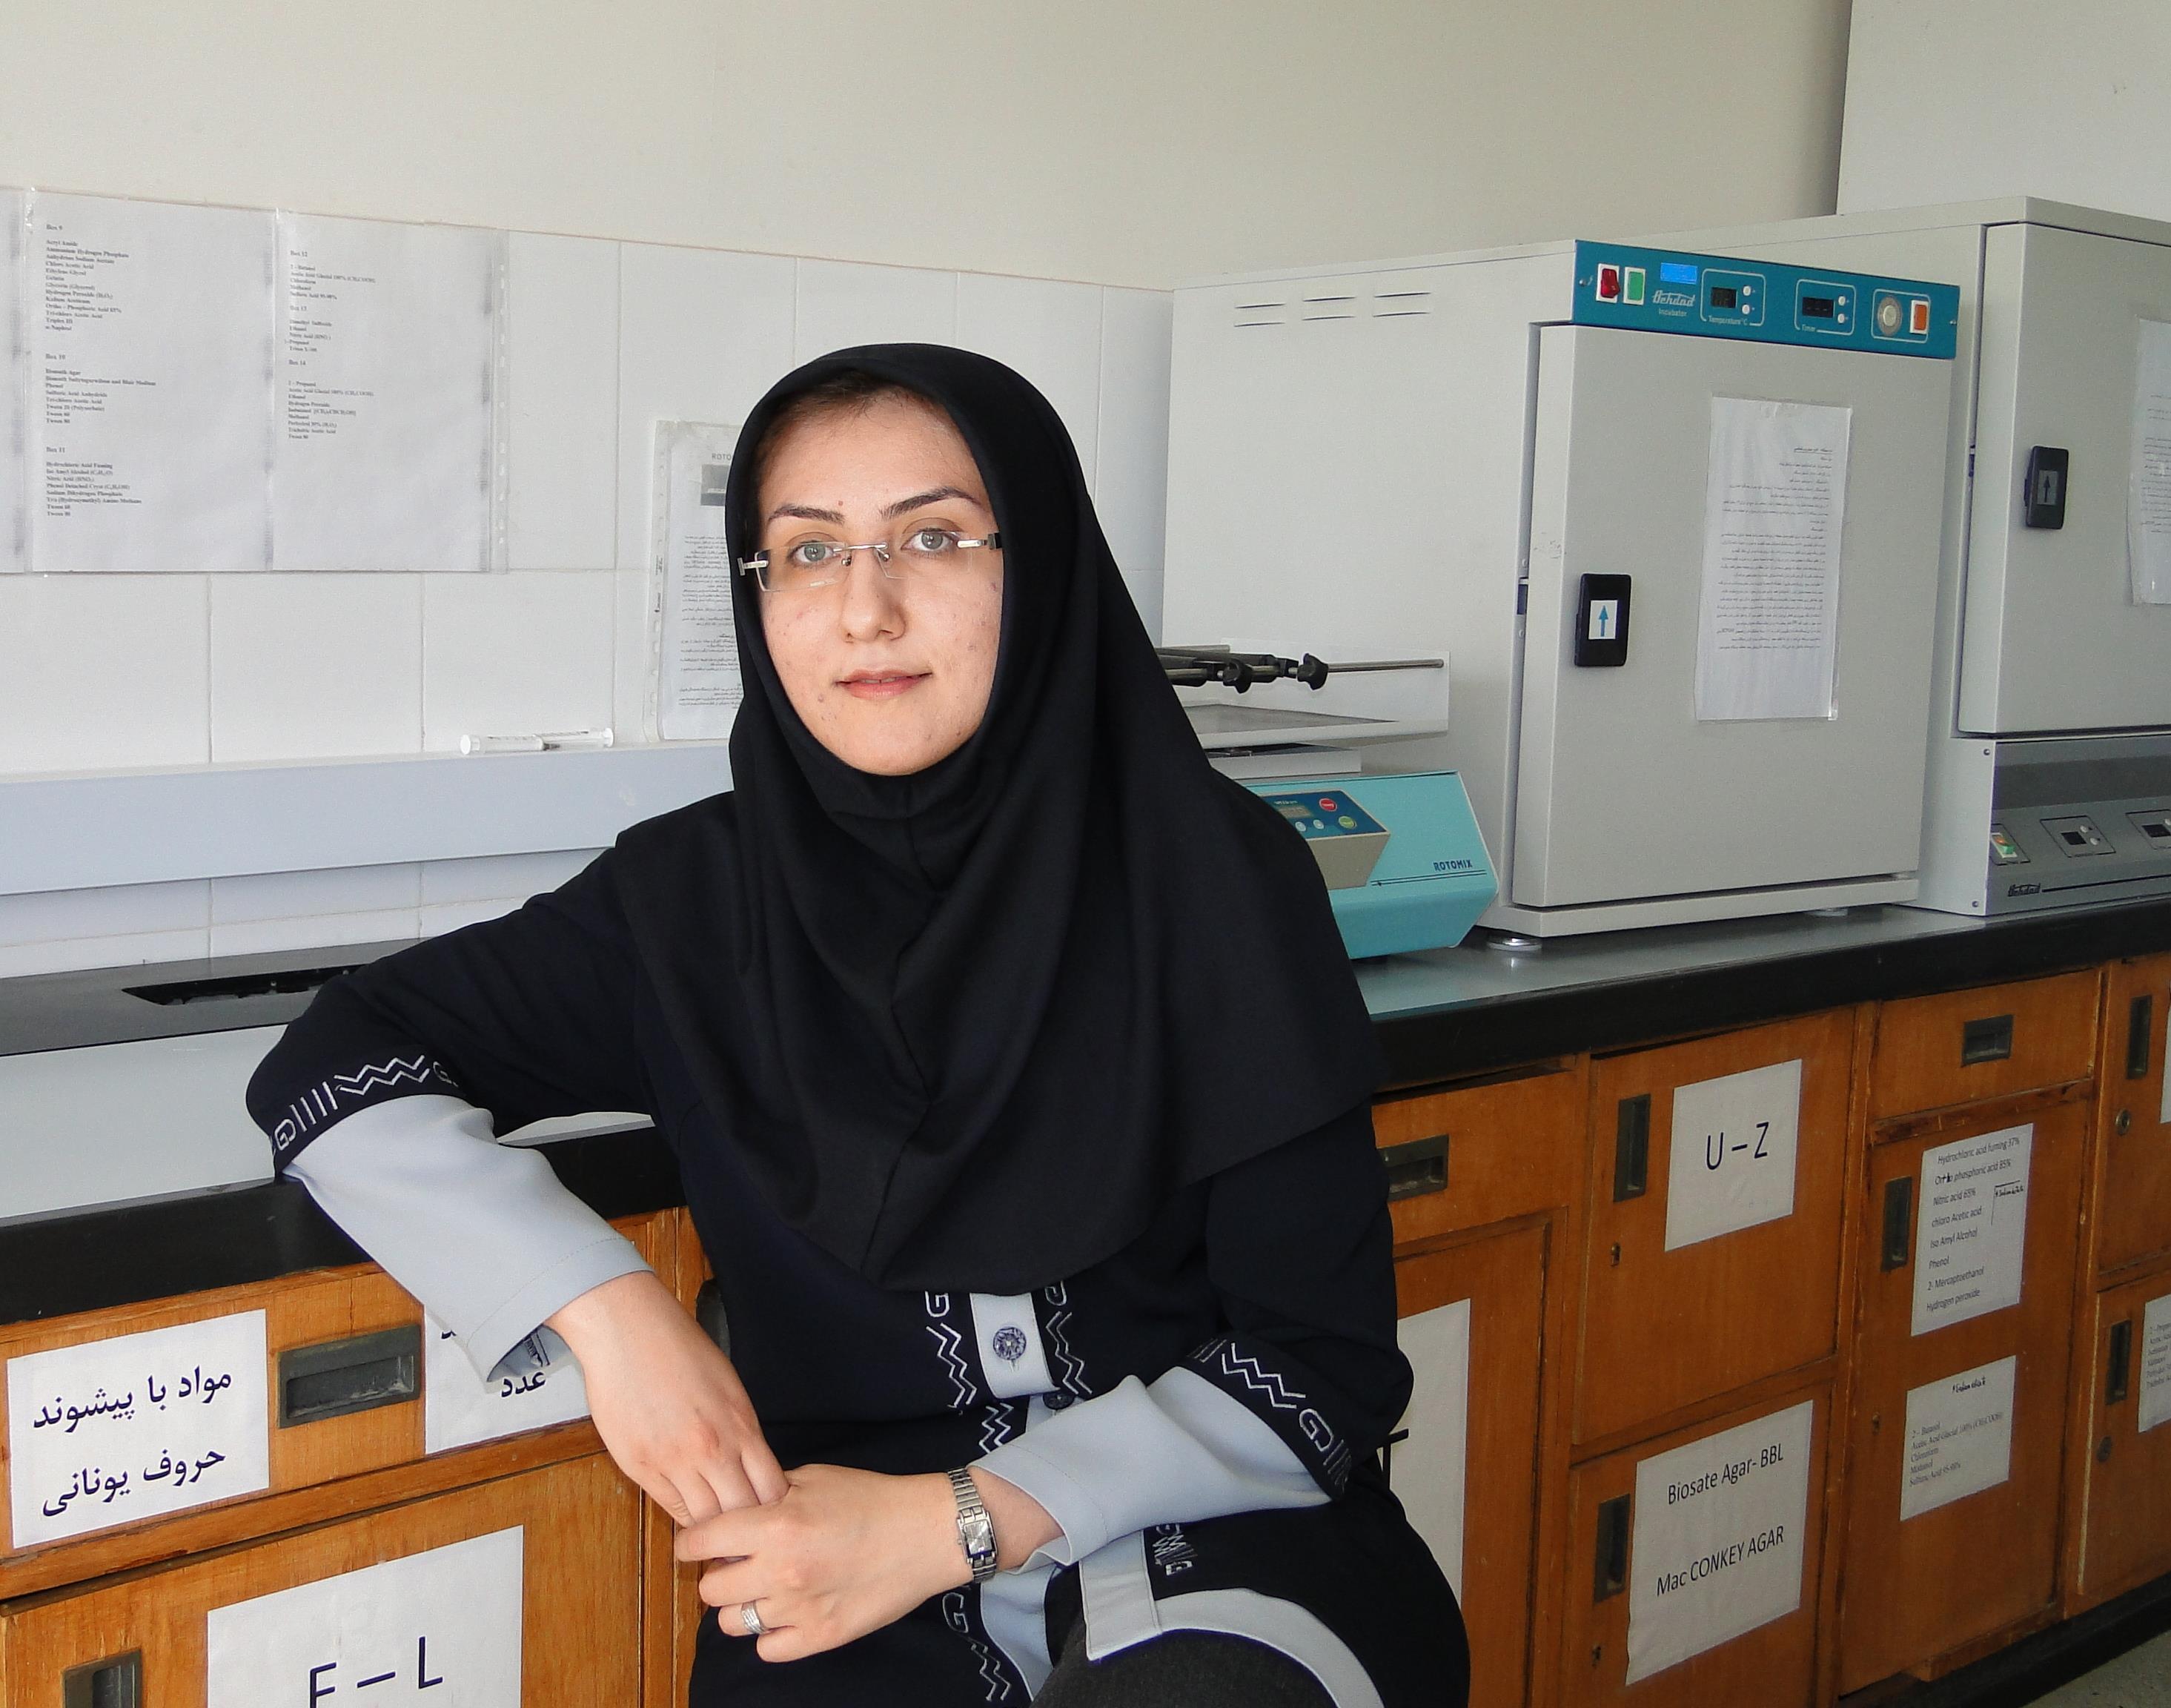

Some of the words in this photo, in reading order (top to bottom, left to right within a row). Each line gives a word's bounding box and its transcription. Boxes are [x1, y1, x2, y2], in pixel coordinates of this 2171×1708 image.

[1433, 859, 1472, 872] ROTOMIX
[1706, 1132, 1724, 1170] U
[1754, 1122, 1769, 1159] Z
[1938, 1149, 1975, 1165] Hydrochloric
[1975, 1145, 1986, 1155] acid
[1954, 1167, 1986, 1182] phosphoric
[1987, 1162, 1998, 1173] acid
[1933, 1195, 1949, 1206] Nitric
[1950, 1191, 1963, 1202] acid
[1951, 1211, 1969, 1222] Acetic
[1970, 1205, 1982, 1217] acid
[1930, 1239, 1939, 1248] Iso
[1940, 1233, 1955, 1245] Amyl
[1956, 1228, 1978, 1241] Alcohol
[1929, 1255, 1950, 1269] Phenol
[1935, 1265, 1984, 1288] Mercaptoethanol
[1926, 1297, 1954, 1311] Hydrogen
[1955, 1288, 1981, 1305] peroxide
[147, 1375, 168, 1412] با
[178, 1366, 232, 1405] مواد
[501, 1371, 546, 1397] عدد
[33, 1386, 136, 1432] پیشوند
[142, 1446, 226, 1485] حروف
[1668, 1472, 1718, 1505] Biosate
[1760, 1443, 1783, 1468] BBL
[42, 1466, 129, 1517] یونانی
[1657, 1571, 1687, 1598] Mac
[1690, 1542, 1744, 1582] CONKEY
[1748, 1526, 1783, 1558] AGAR
[417, 1636, 443, 1689] L
